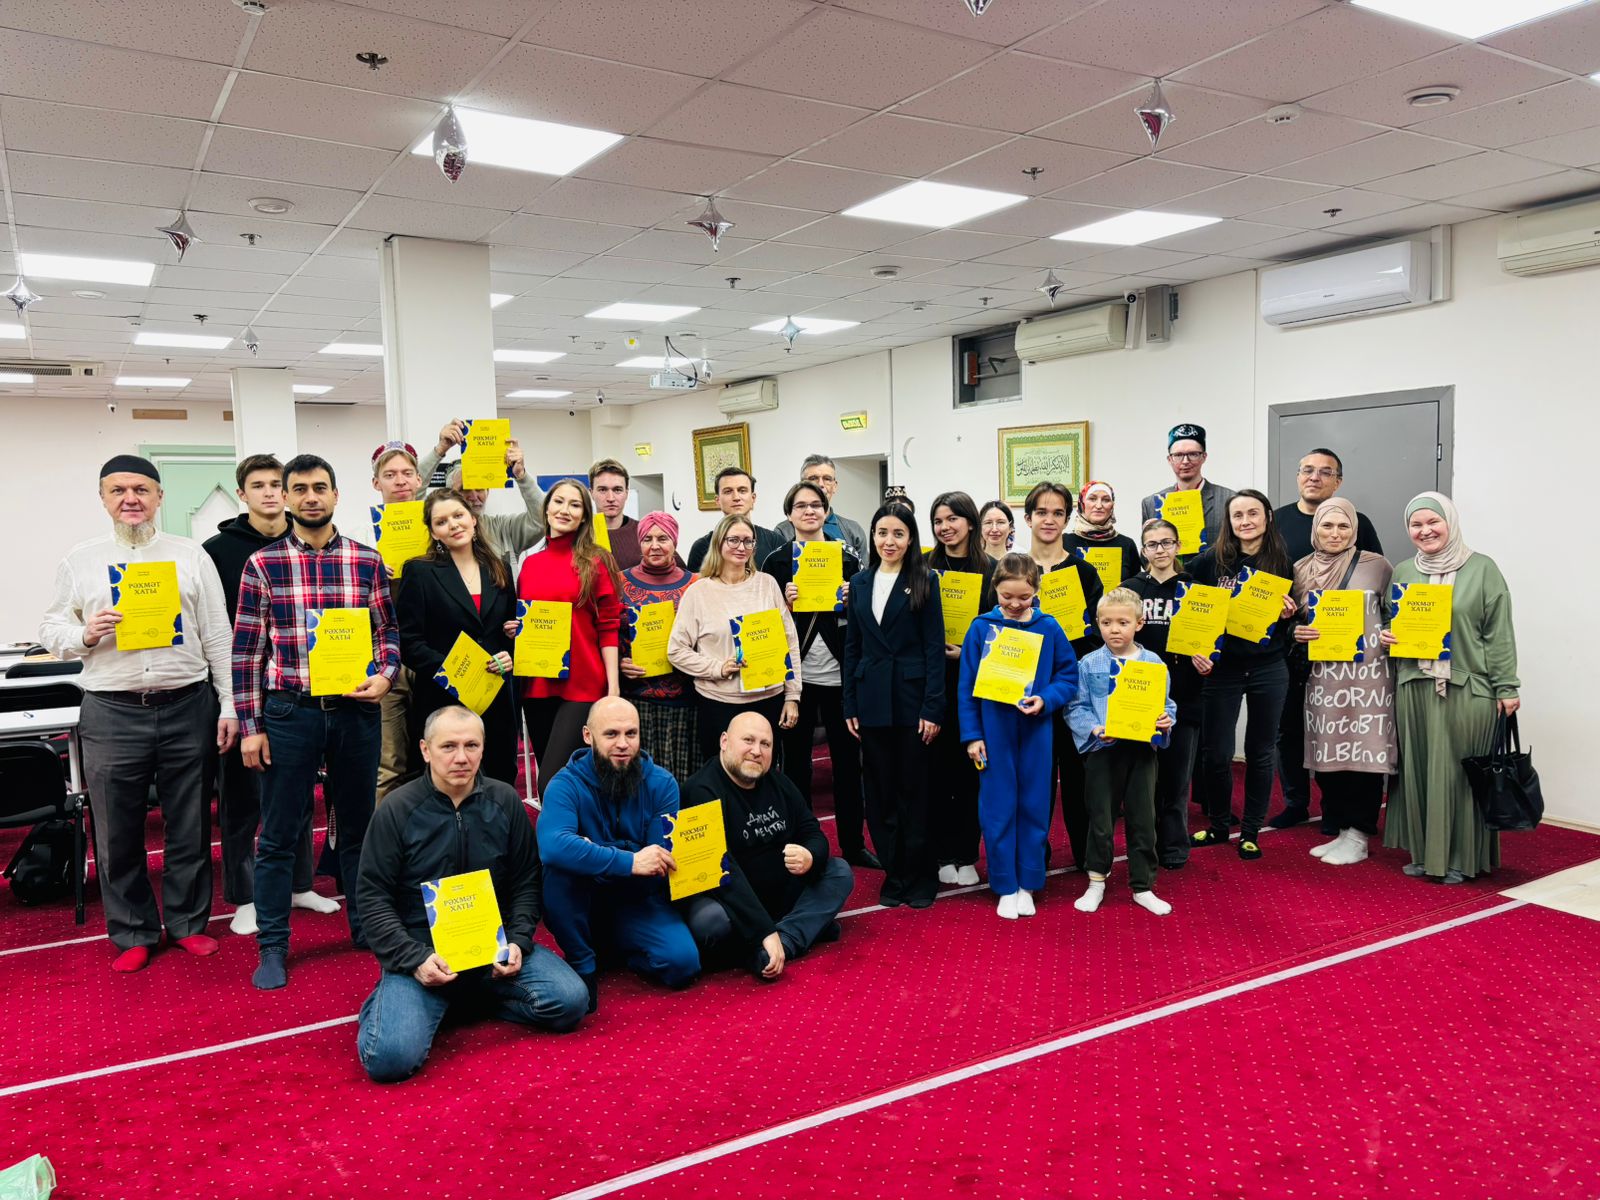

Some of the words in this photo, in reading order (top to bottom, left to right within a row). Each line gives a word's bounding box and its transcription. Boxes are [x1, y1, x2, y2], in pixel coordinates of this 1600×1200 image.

[1049, 591, 1067, 600] ХАТЫ
[1250, 592, 1268, 601] ХАТЫ
[1191, 606, 1210, 614] ХАТЫ
[751, 633, 768, 642] ХАТЫ
[1001, 650, 1020, 659] ХАТЫ
[459, 660, 471, 679] ХАТЫ
[1127, 684, 1147, 692] ХАТЫ
[685, 832, 705, 843] ХАТЫ
[450, 902, 474, 913] ХАТЫ
